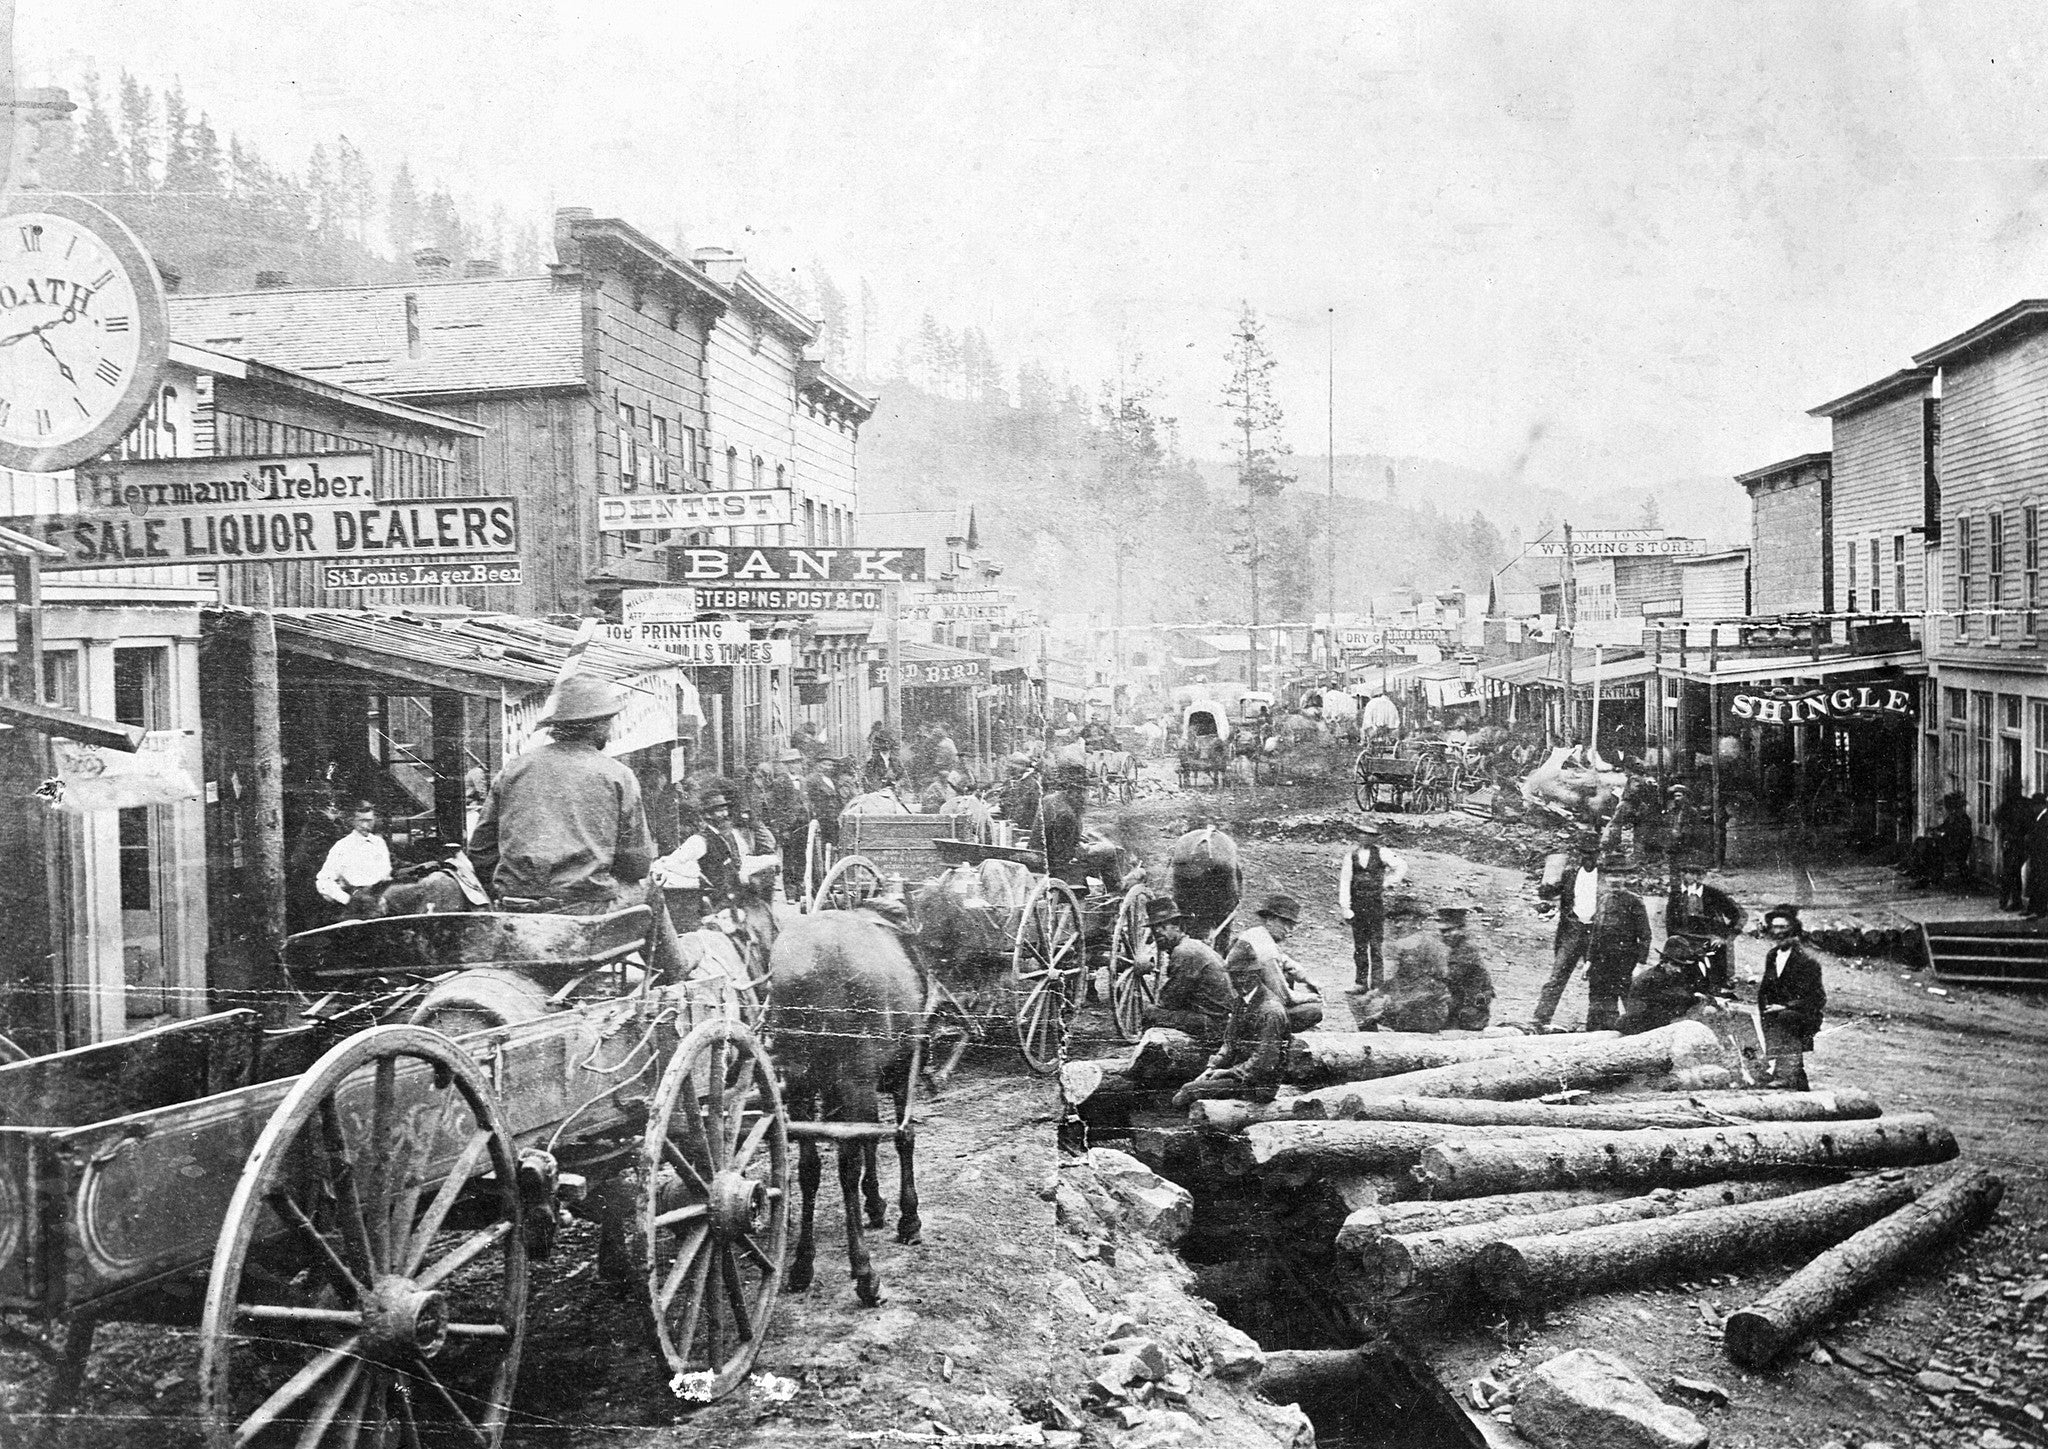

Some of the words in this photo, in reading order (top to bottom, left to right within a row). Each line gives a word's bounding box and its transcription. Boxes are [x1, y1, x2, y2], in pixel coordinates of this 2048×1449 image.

[257, 463, 372, 500] Treber.
[603, 494, 773, 523] DENTIST
[182, 511, 318, 558] LIQUOR
[333, 506, 514, 551] DEALERS
[1541, 542, 1628, 555] WYOMING
[351, 568, 409, 586] Louis
[411, 566, 470, 585] Lager
[470, 564, 521, 582] Beer
[684, 549, 919, 580] BANK.
[941, 603, 1008, 619] MARKET
[641, 624, 723, 639] PRINTING
[718, 642, 774, 665] TIMES
[876, 664, 919, 684] RD
[925, 662, 985, 684] BIRD.
[1731, 687, 1916, 725] SHINGLE.
